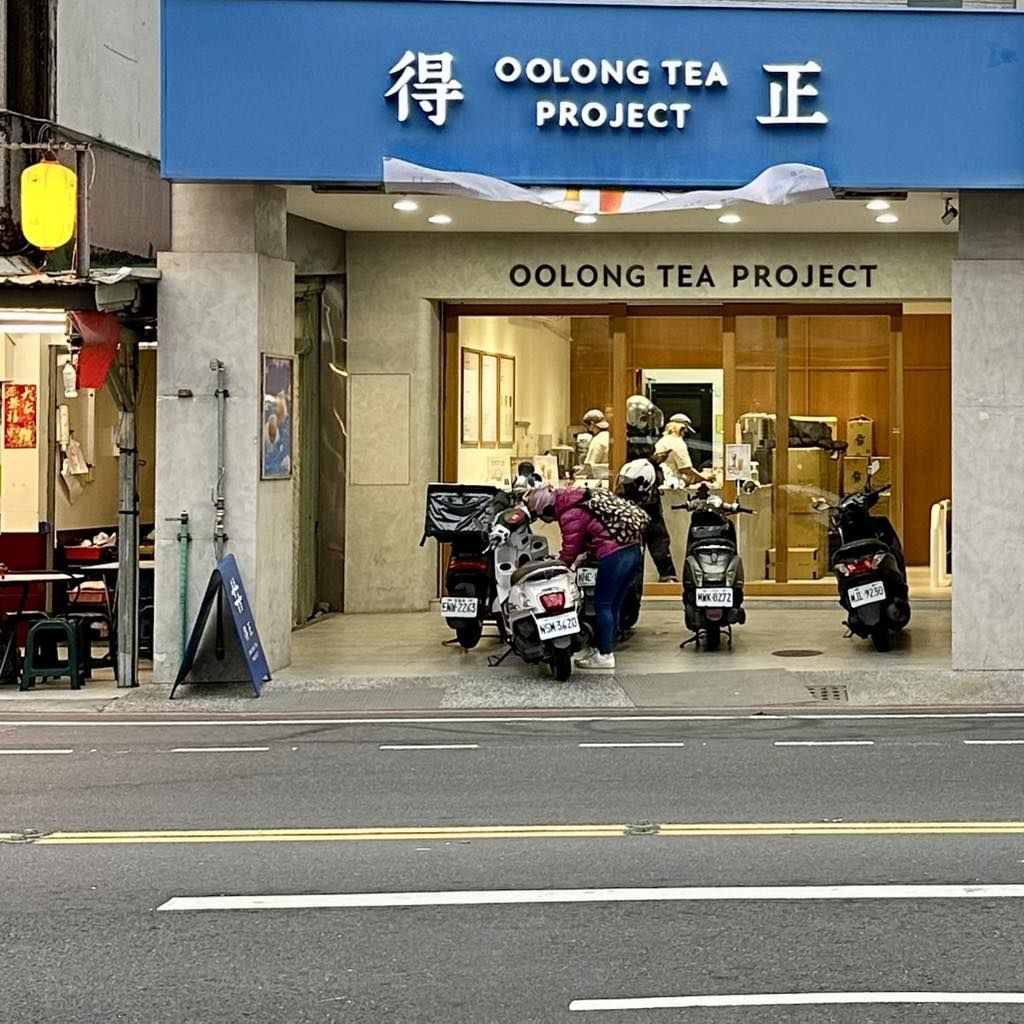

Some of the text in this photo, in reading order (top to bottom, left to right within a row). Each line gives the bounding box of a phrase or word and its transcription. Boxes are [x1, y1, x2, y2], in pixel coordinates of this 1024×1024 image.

[494, 56, 728, 87] OOLONG TEA
[385, 51, 464, 126] 得
[756, 60, 829, 125] 正
[536, 101, 691, 130] PROJECT
[509, 263, 879, 289] OOLONG TEA PROJECT
